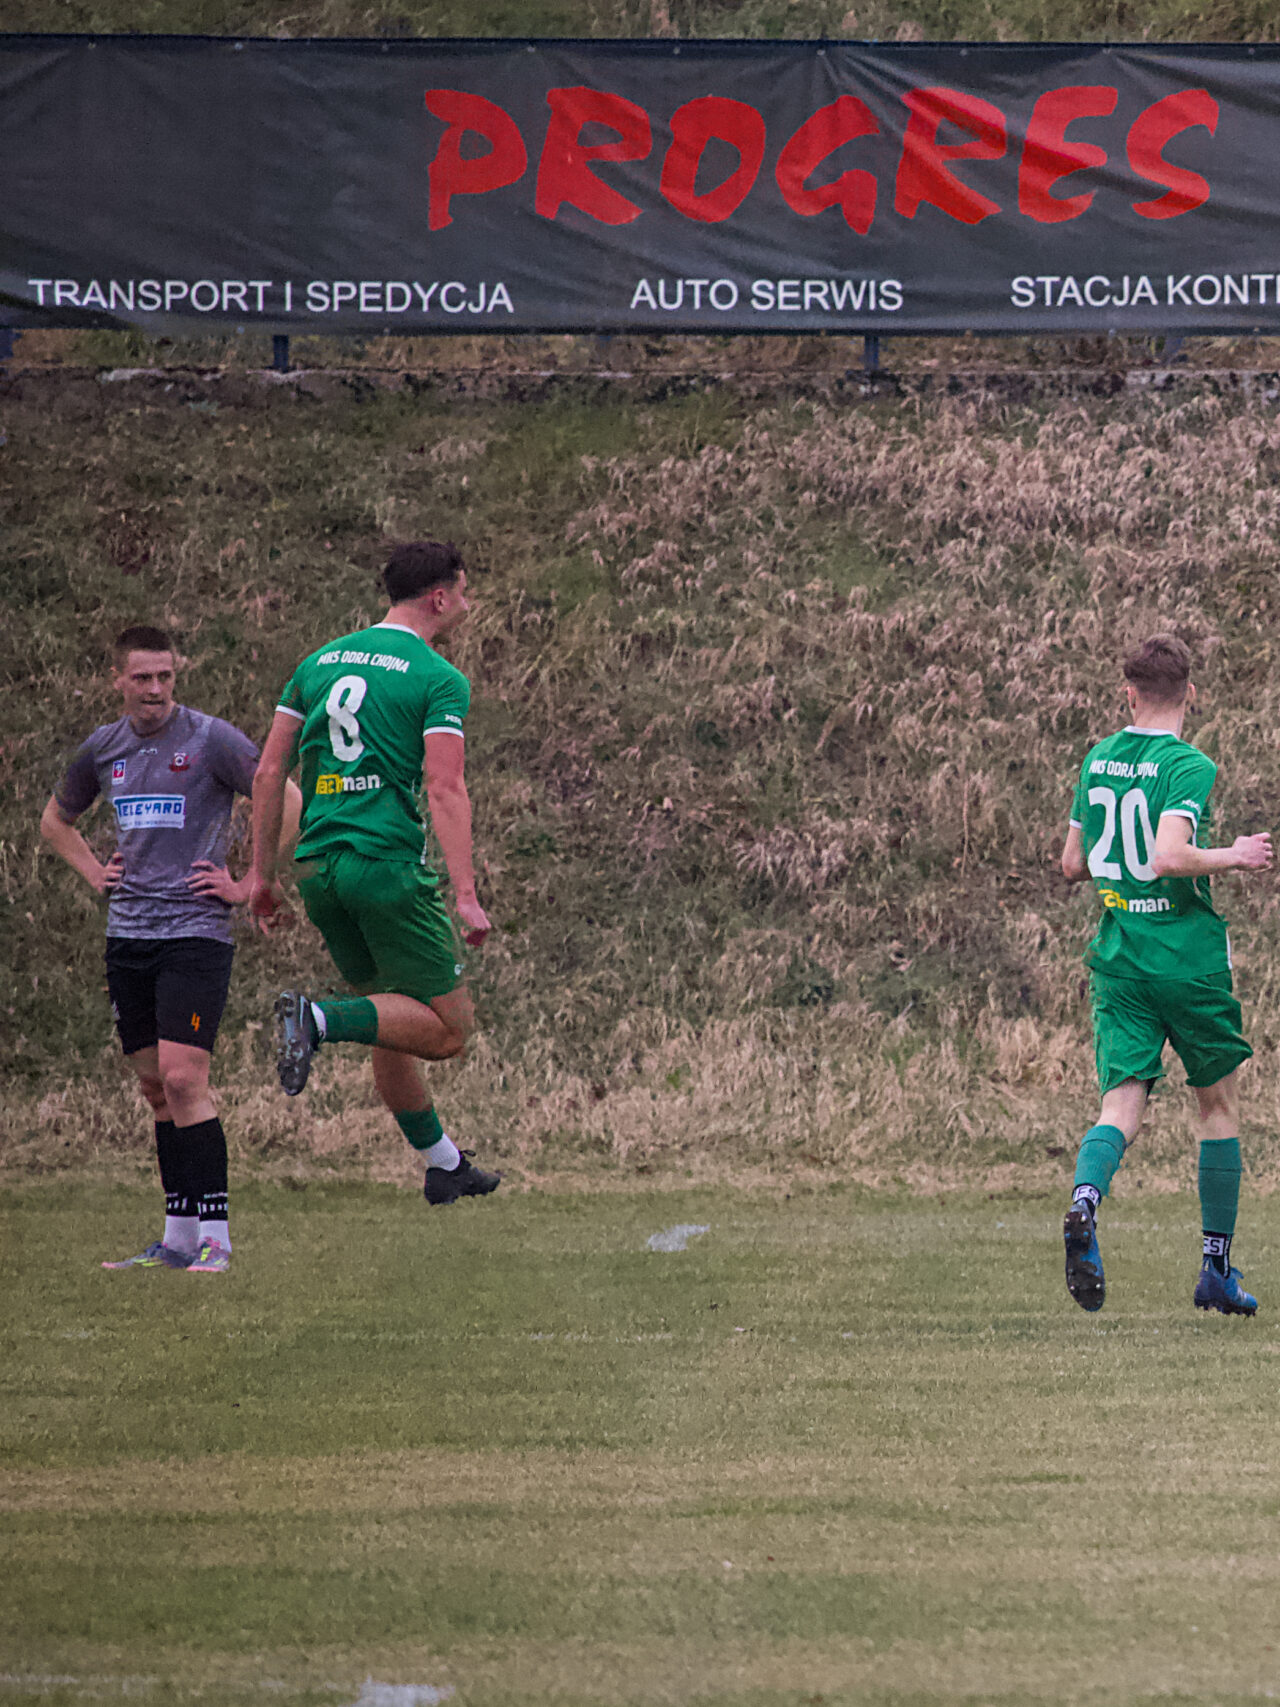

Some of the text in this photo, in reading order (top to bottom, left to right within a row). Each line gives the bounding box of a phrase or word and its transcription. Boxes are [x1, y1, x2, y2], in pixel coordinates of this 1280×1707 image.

[424, 86, 1219, 234] PROGRES
[27, 279, 514, 314] TRANSPORT I SPEDYCJA
[630, 279, 903, 311] AUTO SERWIS
[1011, 275, 1158, 308] STACJA
[341, 650, 370, 665] ODRA
[370, 653, 410, 673] CHOJNA
[326, 675, 367, 762] 8
[1107, 760, 1135, 778] ODRA
[114, 797, 183, 817] TELEYARD
[1088, 787, 1158, 881] 20
